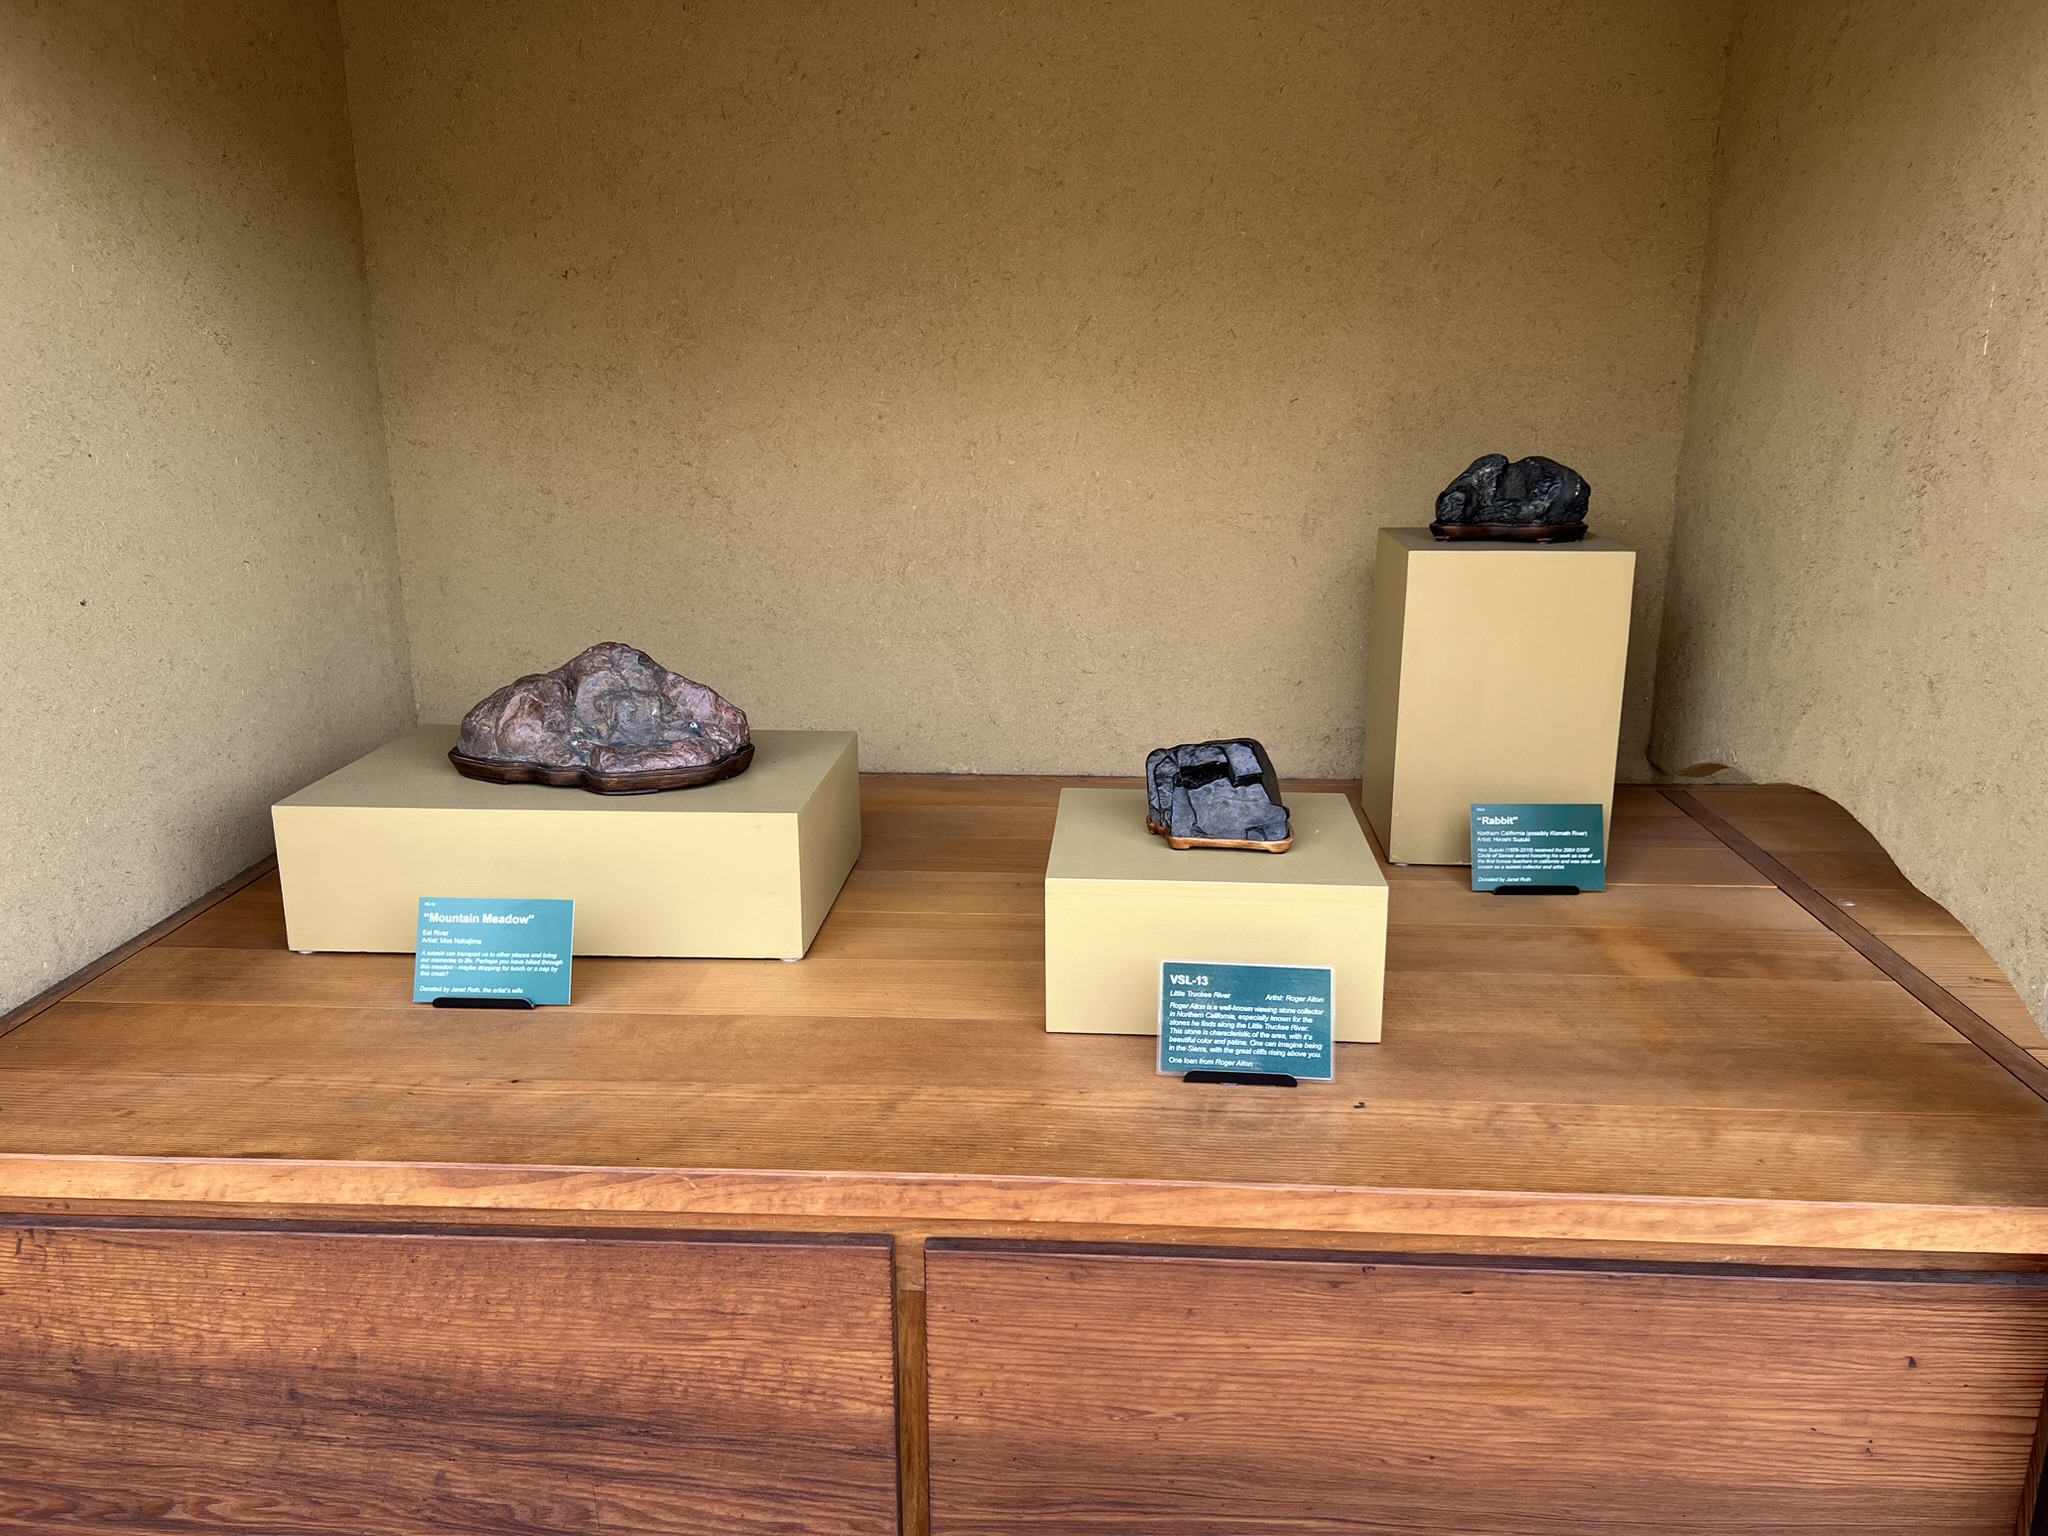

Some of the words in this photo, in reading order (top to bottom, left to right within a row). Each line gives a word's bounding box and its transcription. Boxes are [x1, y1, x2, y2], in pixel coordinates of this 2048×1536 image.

[1476, 816, 1518, 825] “Rabbit”
[423, 913, 479, 923] “Mountain
[482, 913, 535, 924] Meadow”
[454, 938, 482, 946] Nakajima
[1170, 975, 1209, 986] VSL-13
[443, 986, 450, 994] by
[1285, 995, 1305, 1004] Roger
[1169, 1002, 1189, 1011] Roger
[1219, 1004, 1252, 1012] well-known
[1254, 1005, 1277, 1014] viewing
[1278, 1006, 1295, 1014] stone
[1297, 1007, 1324, 1015] collector
[1206, 1012, 1236, 1021] California,
[1238, 1014, 1269, 1023] especially
[1217, 1021, 1235, 1030] along
[1264, 1023, 1289, 1031] Truckee
[1210, 1029, 1250, 1037] characteristic
[1226, 1038, 1248, 1047] patina.
[1278, 1041, 1302, 1049] imagine
[1304, 1042, 1323, 1050] being
[1187, 1046, 1208, 1054] Sierra,
[1235, 1048, 1251, 1056] great
[1268, 1049, 1286, 1057] rising
[1215, 1059, 1235, 1067] Roger
